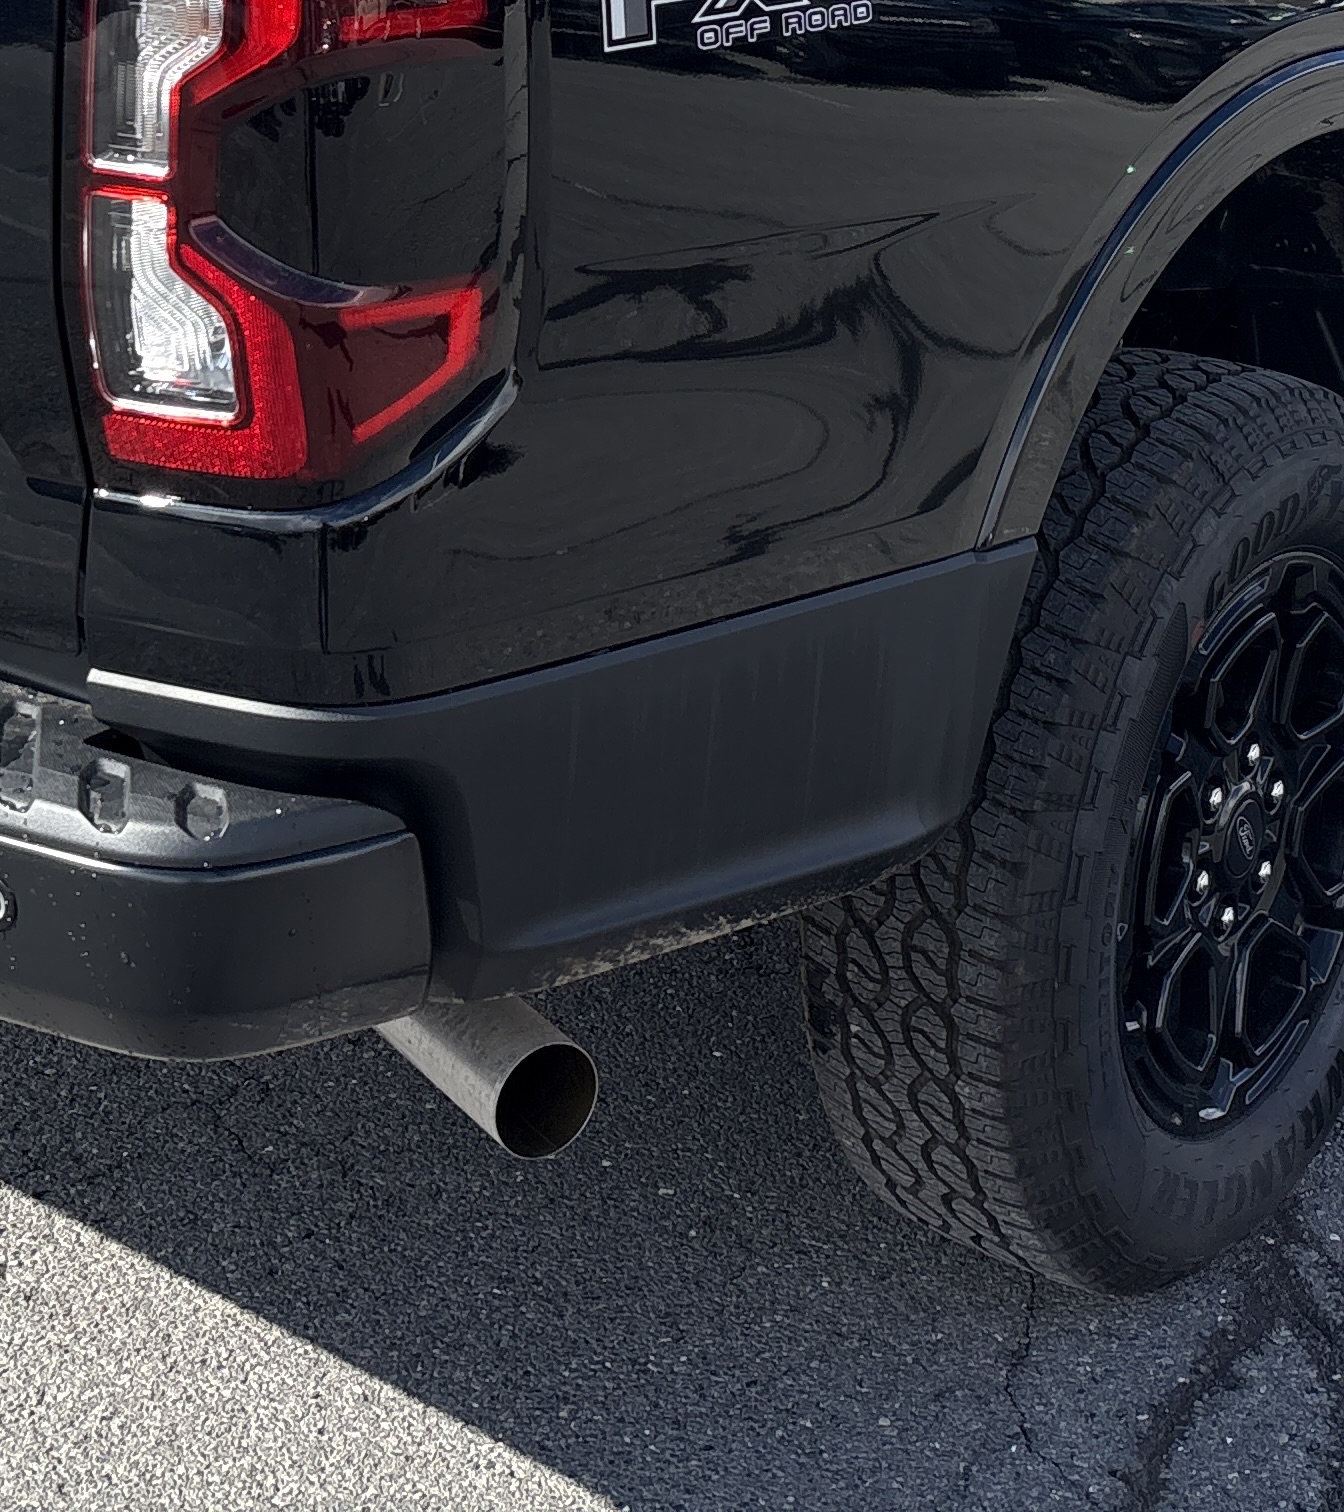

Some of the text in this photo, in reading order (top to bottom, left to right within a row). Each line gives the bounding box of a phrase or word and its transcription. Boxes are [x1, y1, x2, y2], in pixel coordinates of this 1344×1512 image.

[697, 1, 872, 50] OFF ROAD
[1239, 823, 1255, 855] Ford
